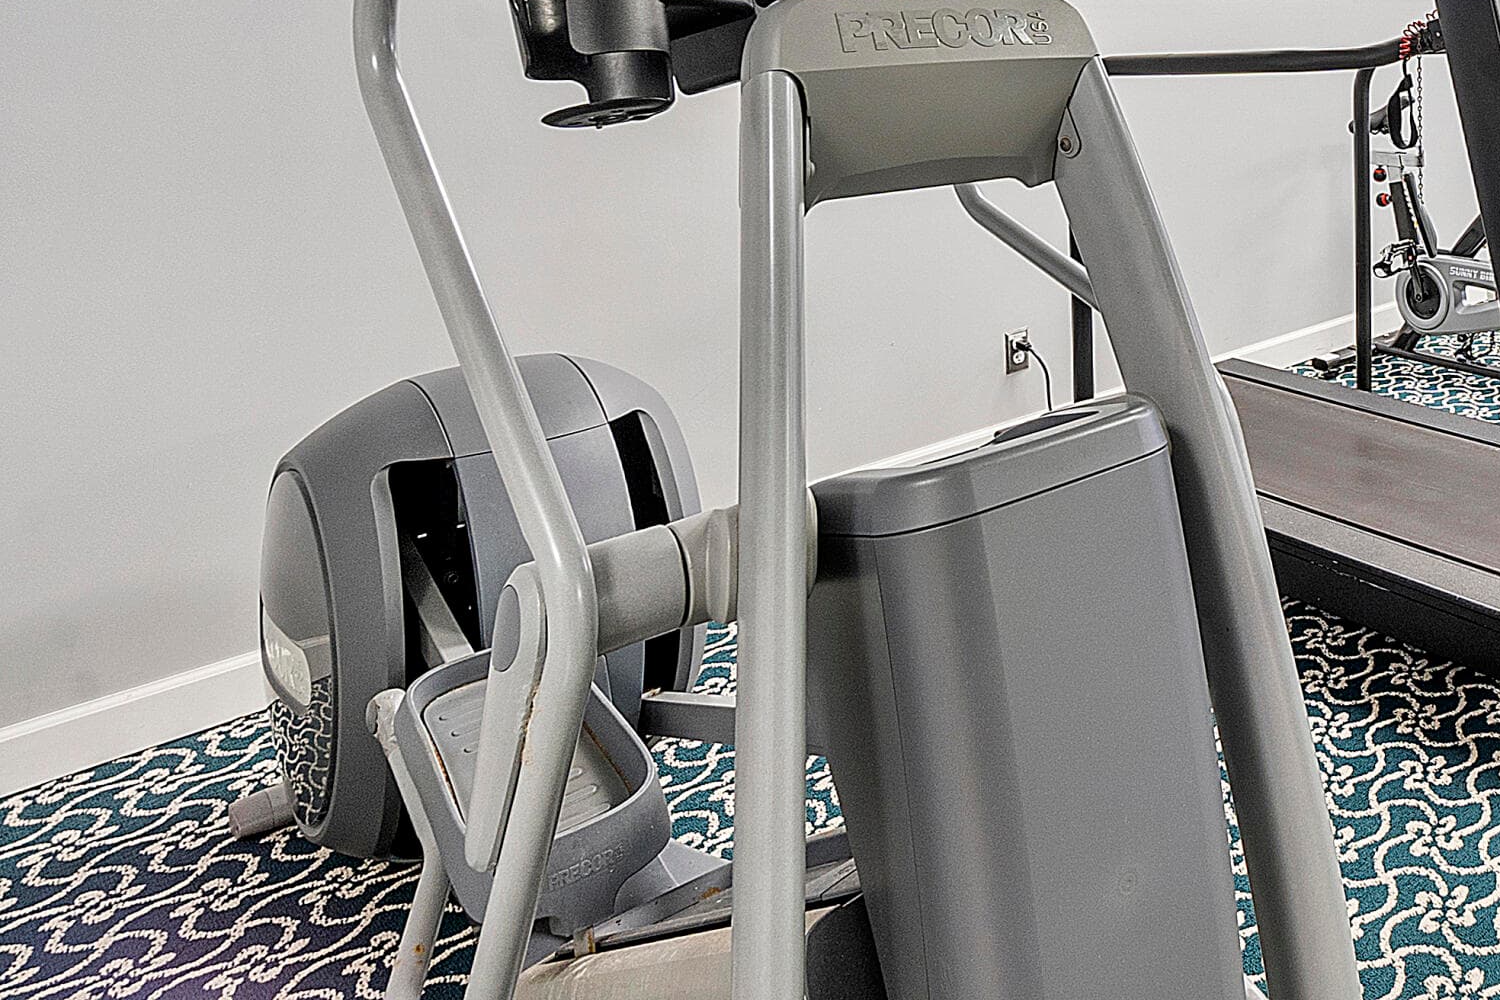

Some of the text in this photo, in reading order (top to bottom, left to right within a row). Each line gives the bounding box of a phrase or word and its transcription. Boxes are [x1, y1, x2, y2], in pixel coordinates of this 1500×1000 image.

[835, 8, 1054, 53] PRECOR USA
[1449, 266, 1478, 279] SUNNY
[549, 849, 614, 891] PRECOR
